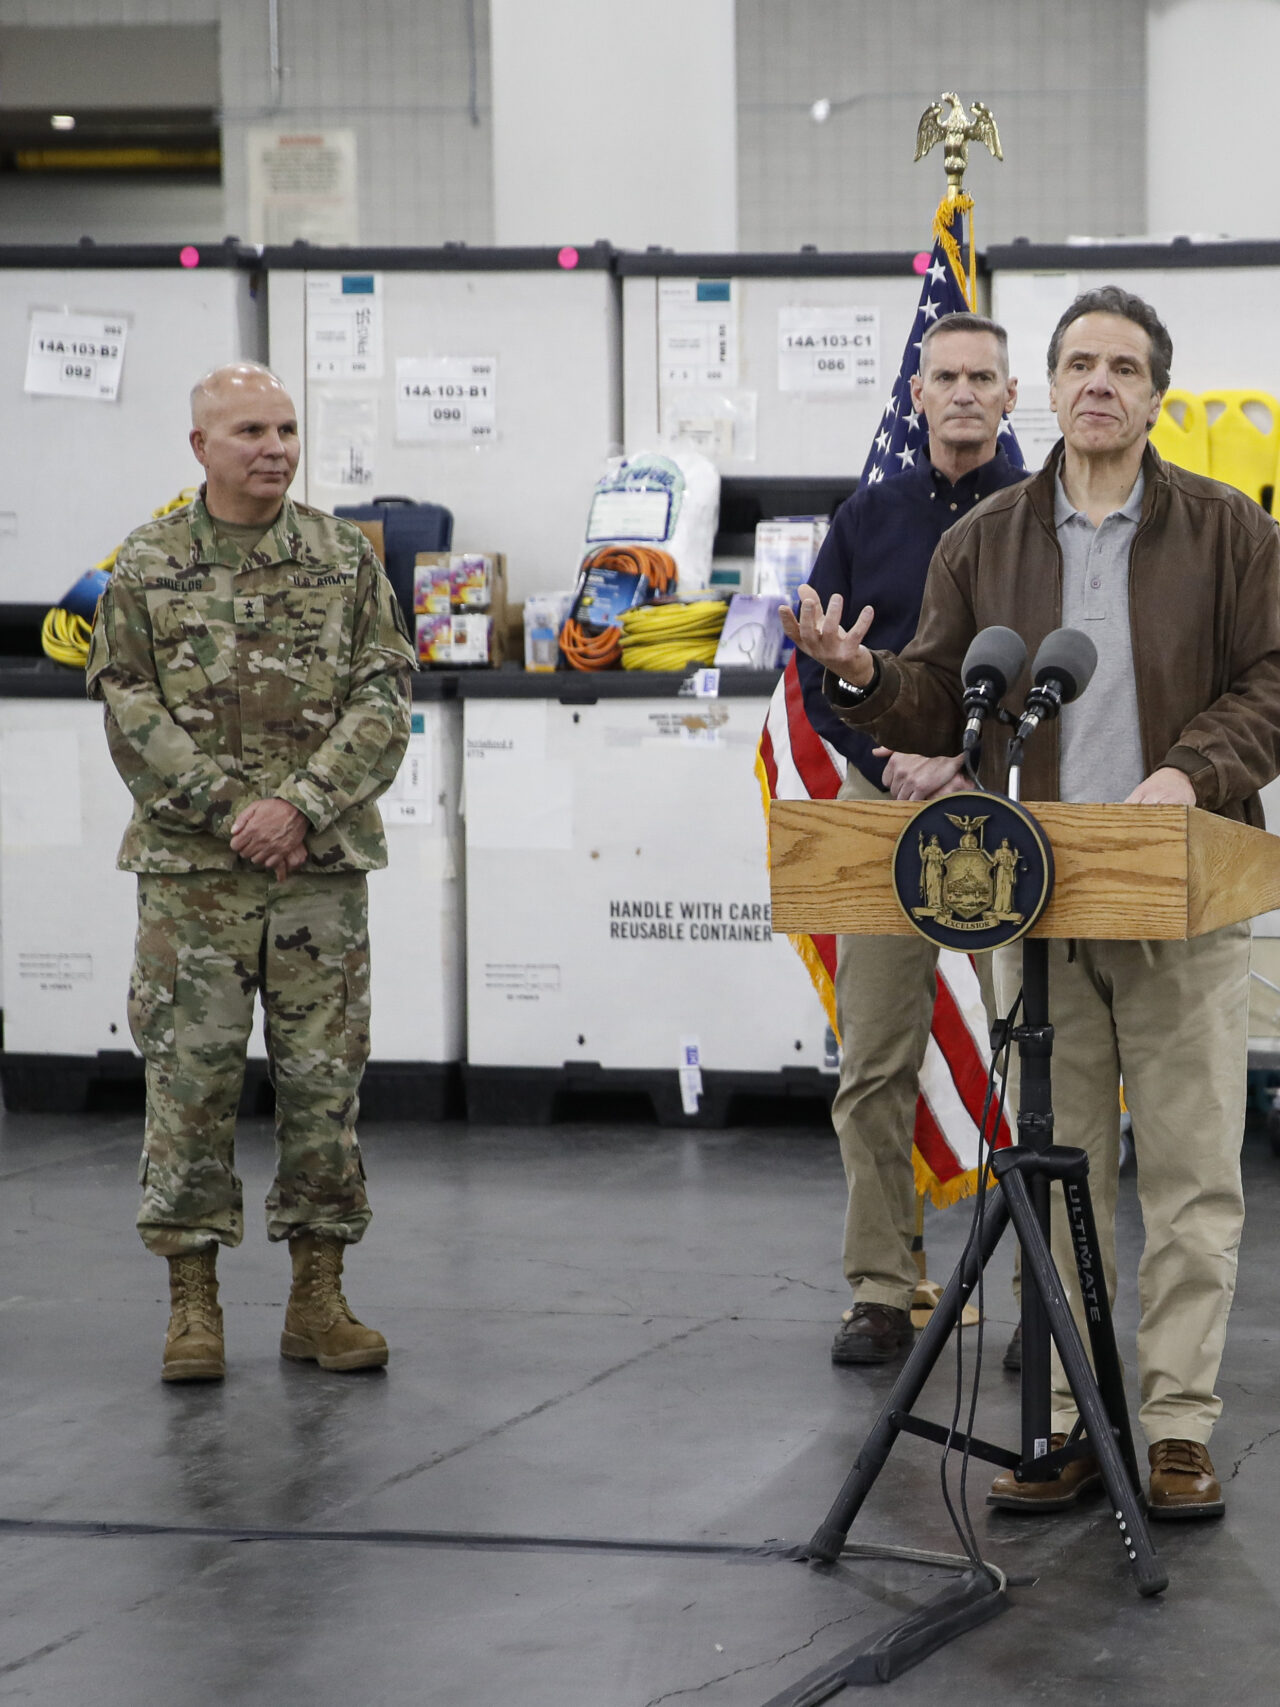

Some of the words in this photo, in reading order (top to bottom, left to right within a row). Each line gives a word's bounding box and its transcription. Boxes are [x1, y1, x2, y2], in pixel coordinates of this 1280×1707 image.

[787, 335, 871, 347] 14A-103-C1
[39, 340, 118, 357] 14A-103-B2
[817, 359, 845, 370] 086
[404, 385, 487, 397] 14A-103-B1
[433, 408, 461, 420] 090
[156, 577, 202, 591] SHIELDS
[610, 900, 673, 918] HANDLE
[680, 902, 723, 919] WITH
[729, 903, 772, 921] CARE
[944, 919, 991, 929] EXCELSIOR
[610, 921, 685, 940] REUSABLE
[690, 923, 773, 941] CONTAINER
[1068, 1184, 1102, 1322] ULTIMATE
